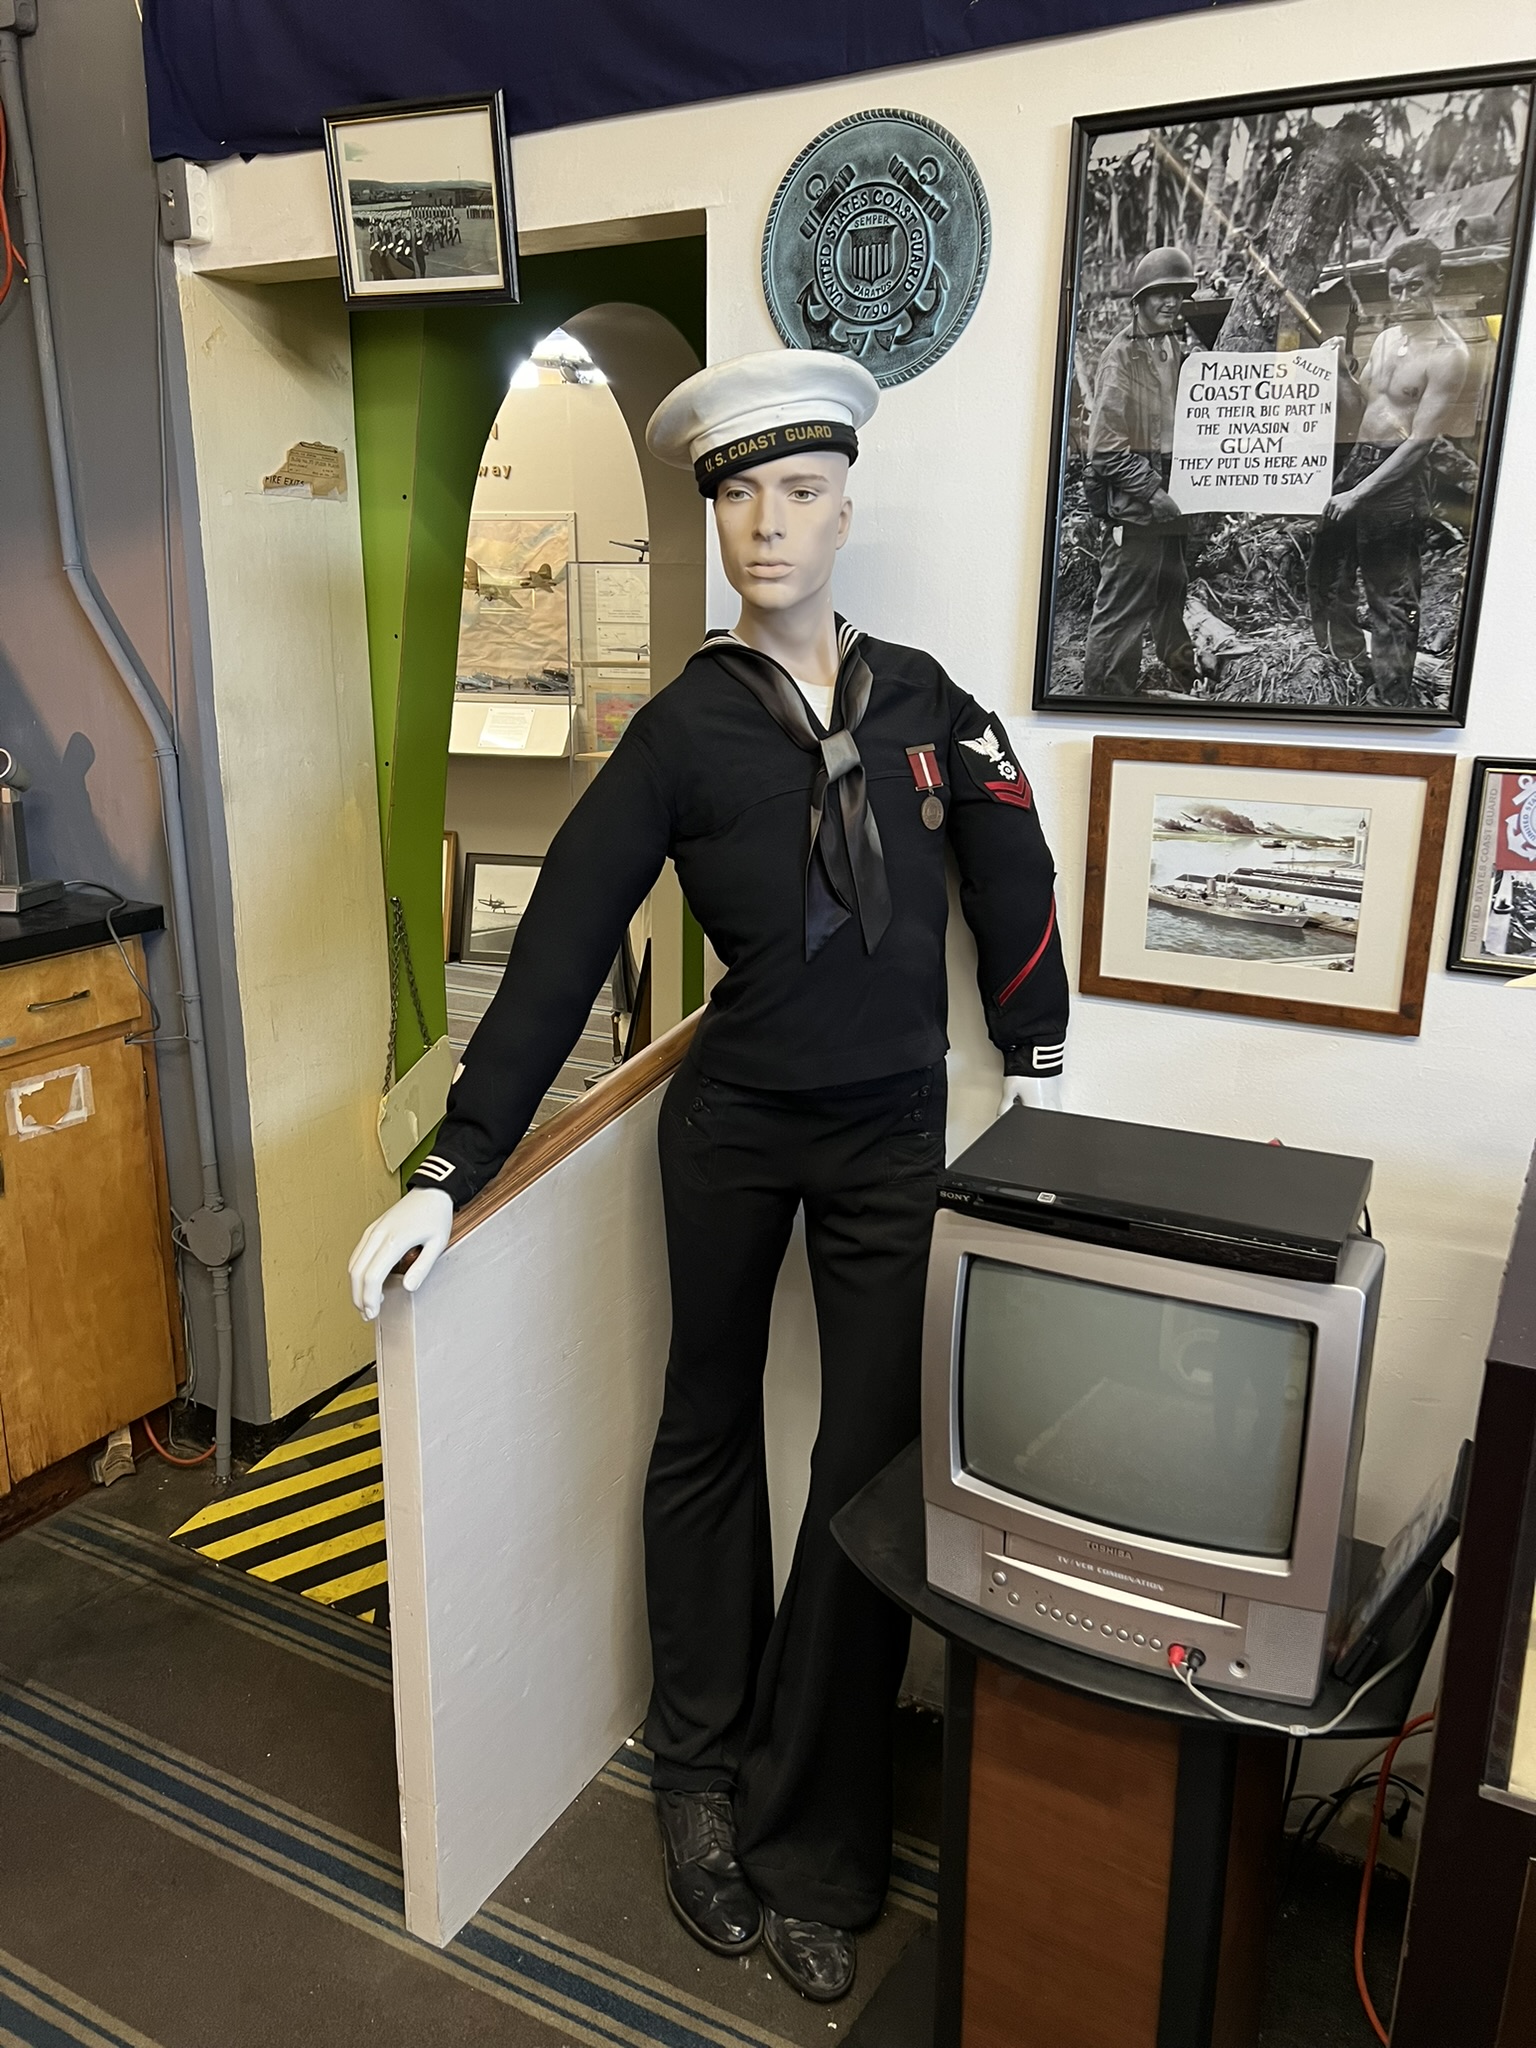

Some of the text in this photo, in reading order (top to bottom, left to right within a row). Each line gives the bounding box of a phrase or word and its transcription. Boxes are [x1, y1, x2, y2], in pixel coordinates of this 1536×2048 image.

[854, 215, 890, 229] SEMPER
[820, 189, 926, 307] UNITED STATES COAST GUARD
[853, 280, 893, 298] PARATUS
[854, 301, 890, 318] 1790
[1201, 362, 1288, 381] MARINES
[1293, 356, 1332, 381] SALUTE
[1189, 381, 1319, 402] COAST GUARD
[1187, 401, 1332, 419] FOR THEIR BIG PART IN
[1197, 421, 1318, 435] THE INVASION OF
[705, 425, 832, 472] U.S. COAST GUARD
[1220, 436, 1284, 454] GUAM
[1217, 457, 1240, 469] PUT
[1244, 457, 1260, 469] US
[1264, 456, 1298, 468] HERE
[1301, 455, 1327, 467] AND
[1190, 475, 1212, 487] WE
[1215, 474, 1259, 486] INTEND
[1263, 474, 1278, 486] TO
[1469, 788, 1498, 942] UNITED STATES COAST GUARD
[939, 1190, 971, 1202] SONY
[1085, 1540, 1134, 1560] TOSHIBA
[1097, 1567, 1164, 1591] COMBINATION
